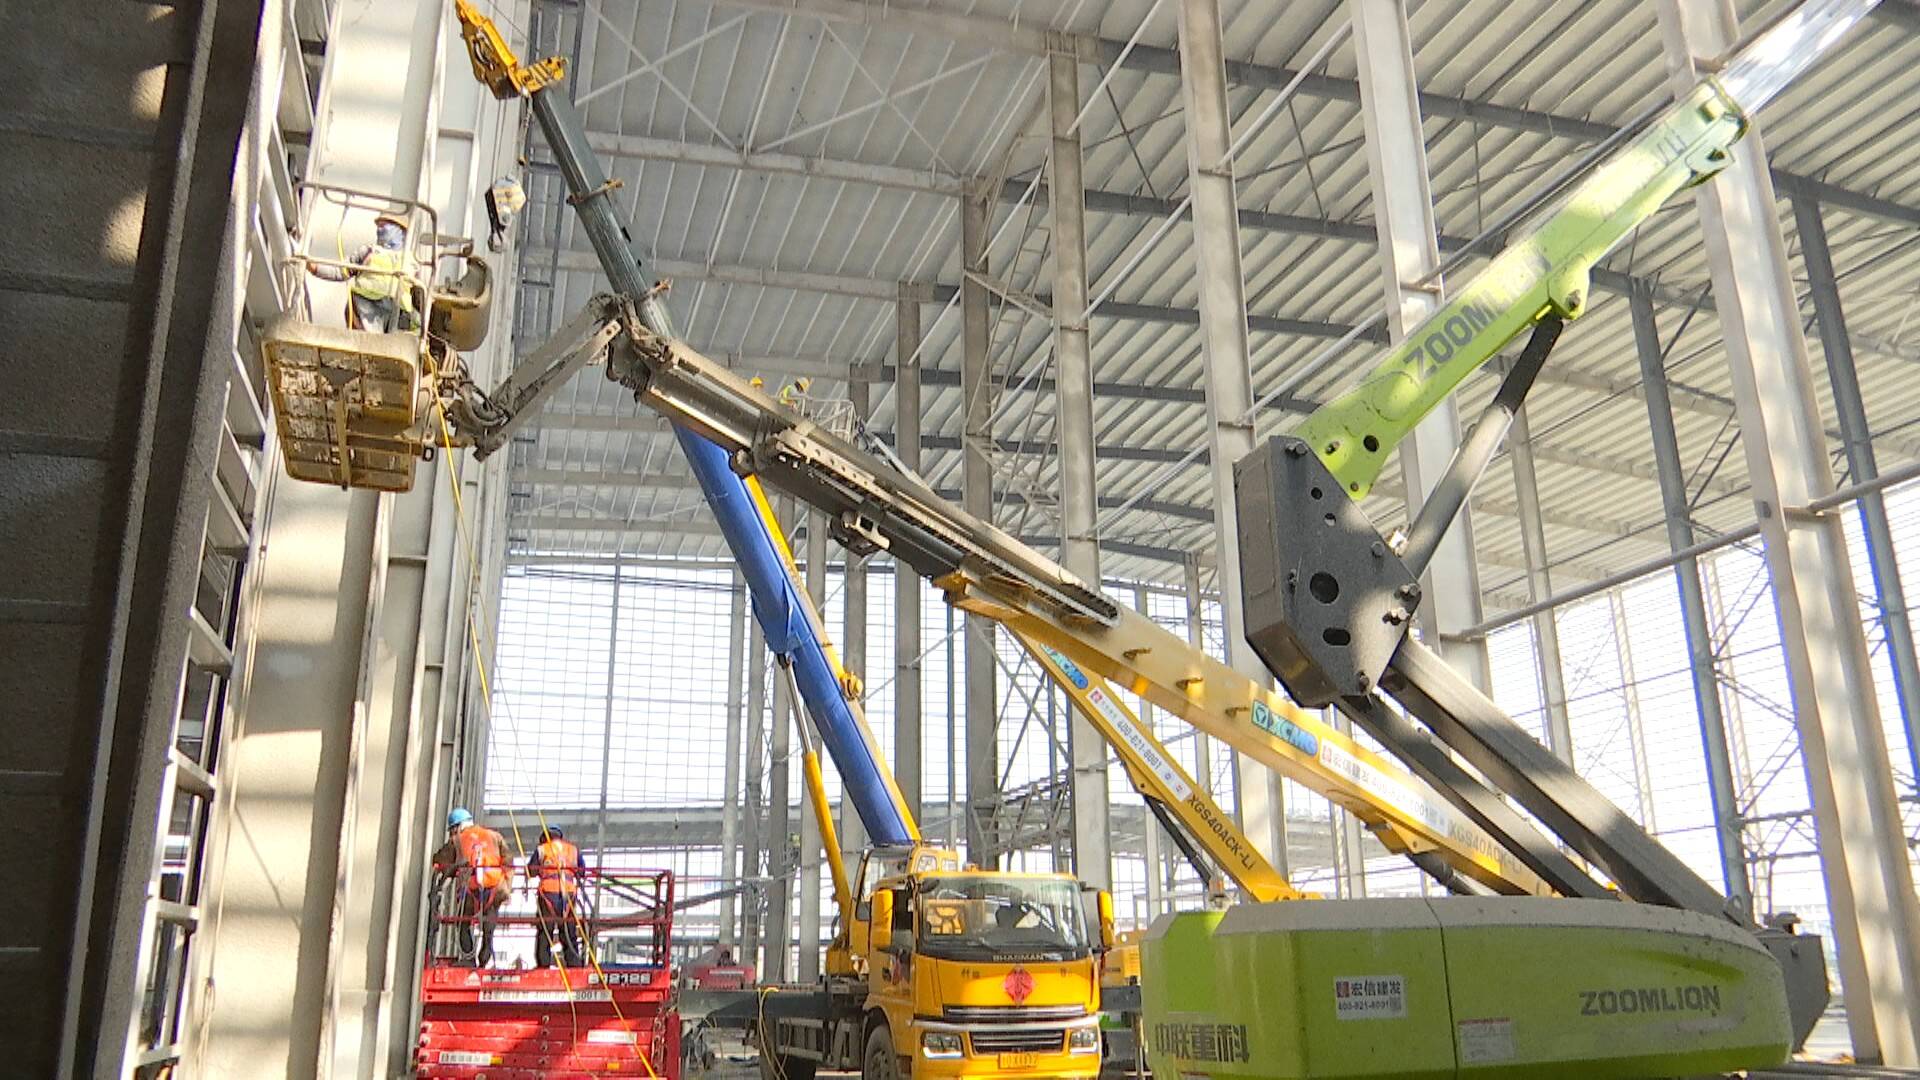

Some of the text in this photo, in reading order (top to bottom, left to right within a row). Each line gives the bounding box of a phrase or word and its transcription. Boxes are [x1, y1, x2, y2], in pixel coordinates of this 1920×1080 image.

[1351, 979, 1401, 998] 宏信建发
[1579, 985, 1720, 1016] ZOOMLION
[1154, 1023, 1250, 1064] 中联重科
